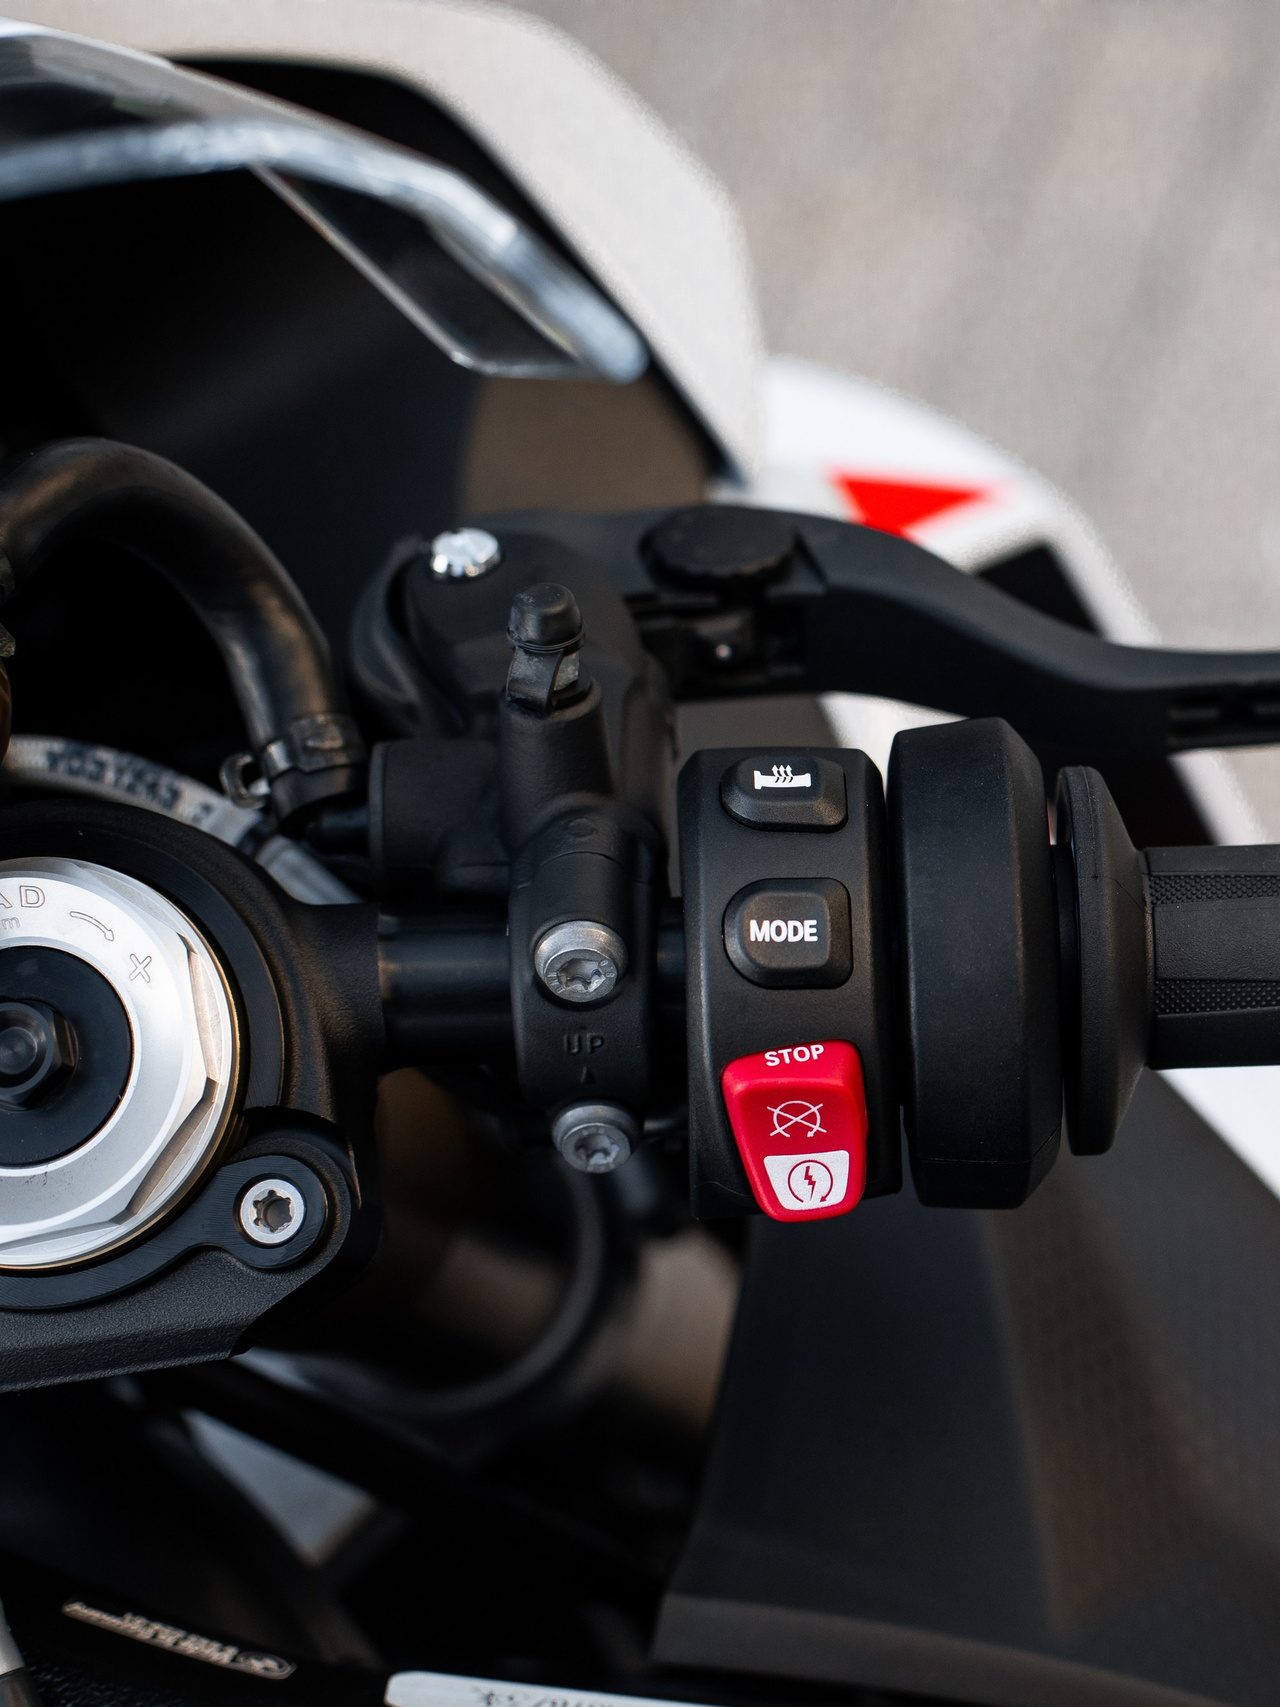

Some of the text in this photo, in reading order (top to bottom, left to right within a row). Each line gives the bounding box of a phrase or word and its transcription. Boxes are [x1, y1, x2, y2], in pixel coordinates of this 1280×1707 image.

[749, 919, 819, 943] MODE
[563, 1032, 605, 1056] UP
[764, 1044, 824, 1067] STOP
